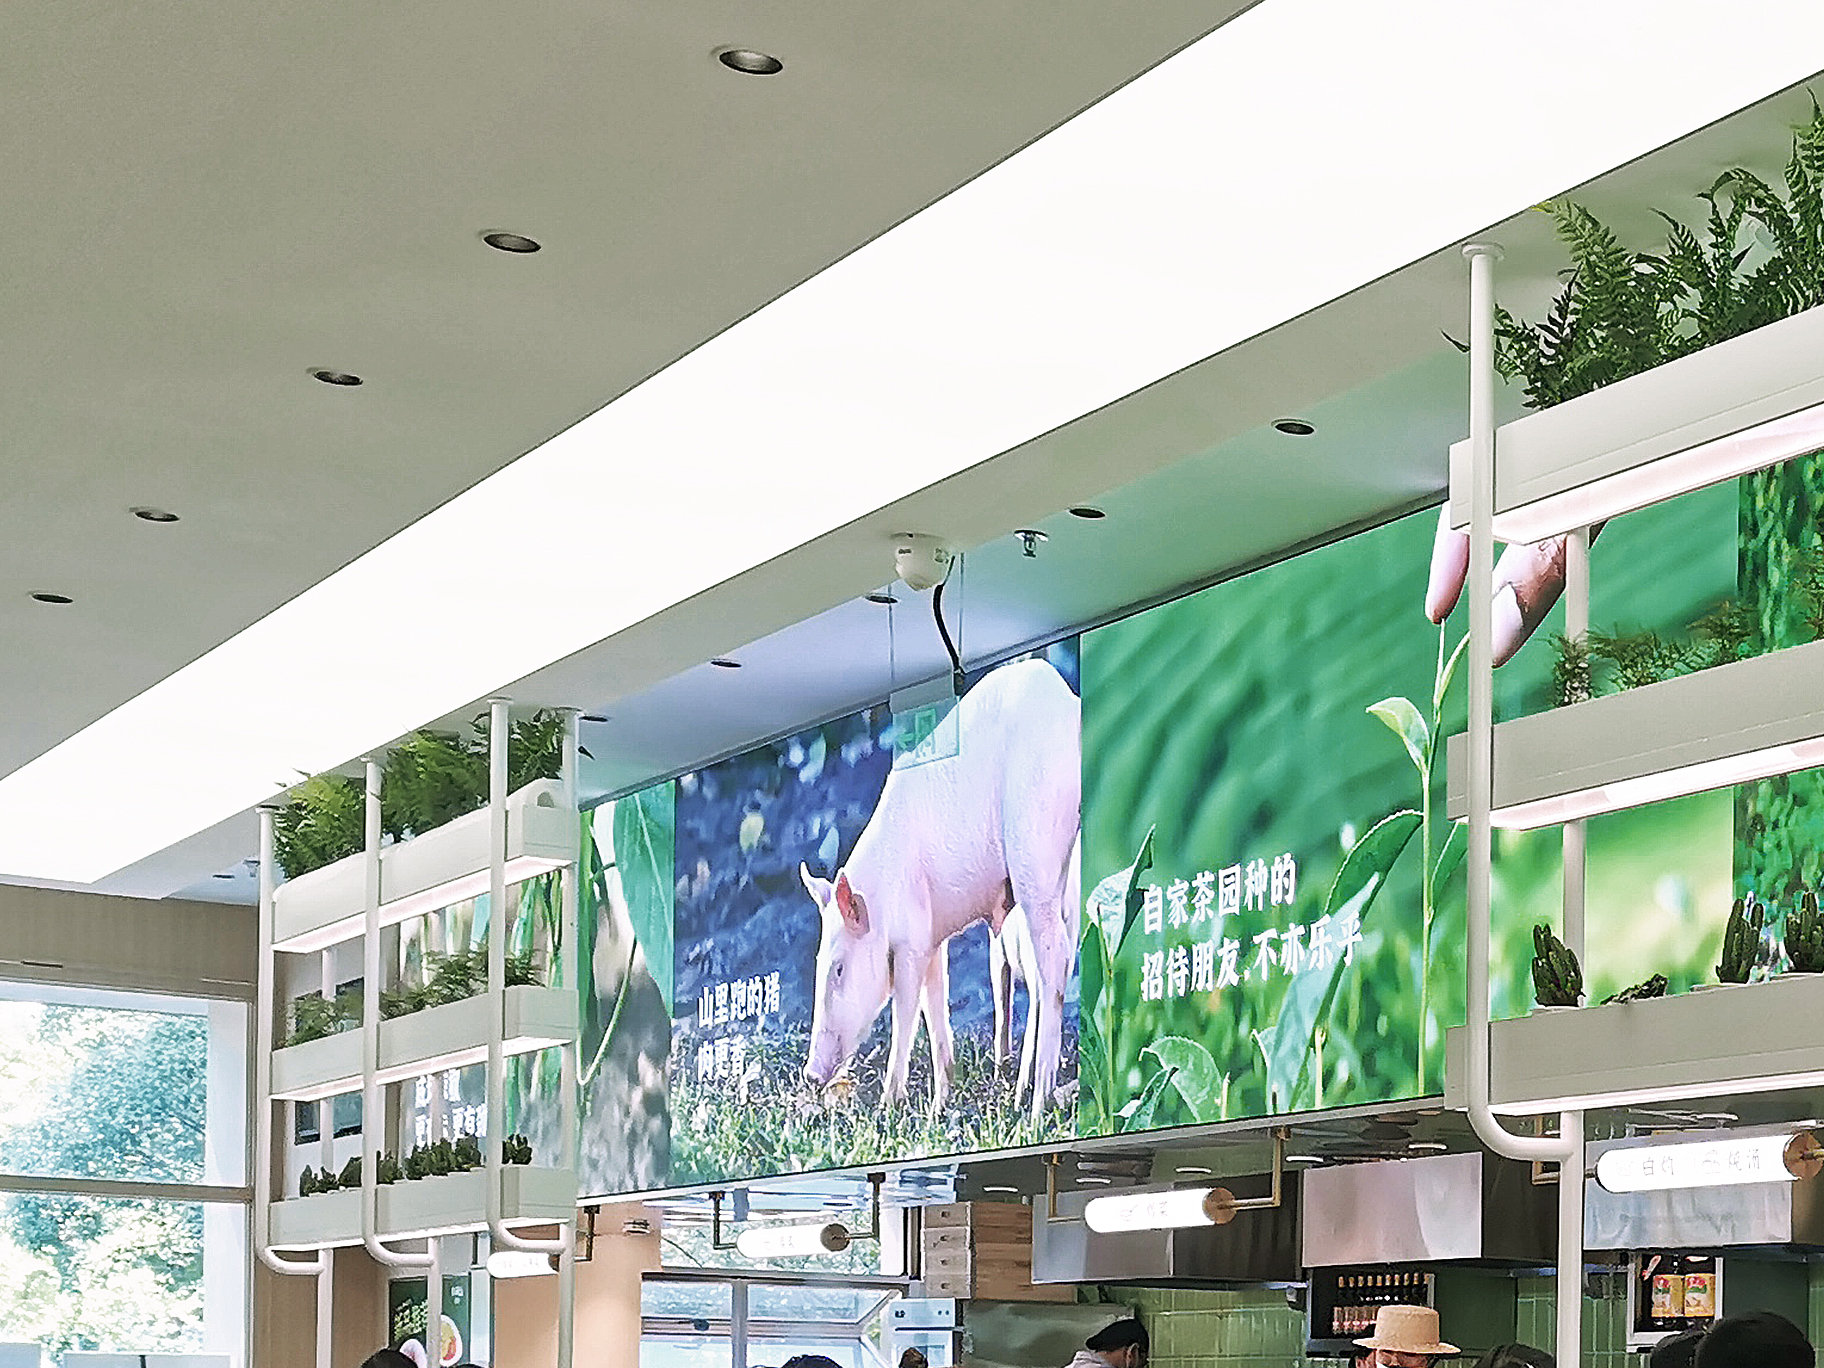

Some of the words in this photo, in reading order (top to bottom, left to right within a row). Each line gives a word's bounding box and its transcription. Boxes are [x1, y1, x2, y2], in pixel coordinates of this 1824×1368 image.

[1145, 852, 1296, 935] 自家茶园种的
[1141, 910, 1364, 1002] 招待朋友，不亦乐乎
[698, 971, 780, 1030] 山里跑的猪
[698, 1033, 747, 1082] 肉更香
[1643, 1156, 1674, 1176] 白灼
